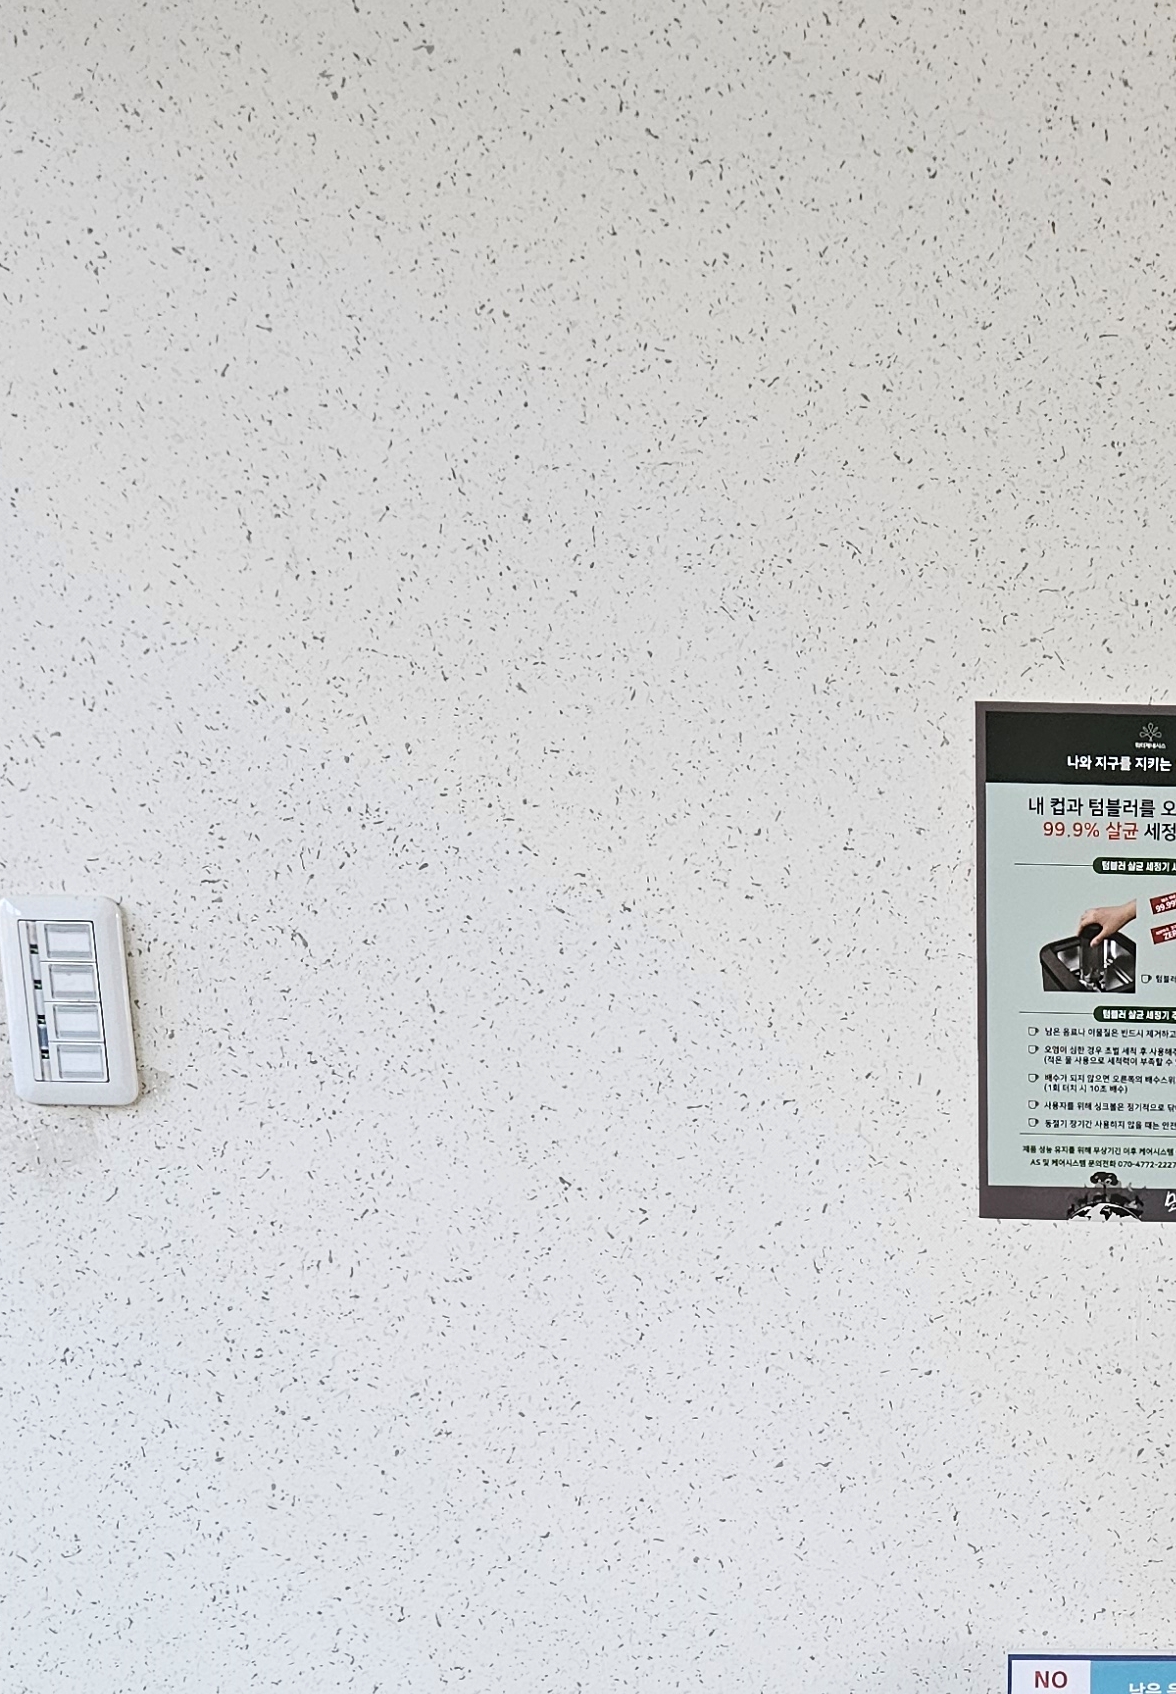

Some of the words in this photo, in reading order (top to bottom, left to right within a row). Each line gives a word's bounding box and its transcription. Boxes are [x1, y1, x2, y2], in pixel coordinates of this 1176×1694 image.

[1067, 755, 1092, 770] 나와
[1095, 756, 1131, 771] 지구를
[1135, 757, 1172, 771] 지키는
[1029, 797, 1044, 816] 내
[1050, 798, 1083, 816] 컵과
[1089, 798, 1155, 818] 텀블러를
[1043, 821, 1100, 838] 99.9%
[1105, 822, 1139, 840] 살균
[1102, 861, 1126, 871] 텀블러
[1128, 861, 1144, 871] 살균
[1146, 862, 1170, 872] 세정기
[1103, 1010, 1126, 1019] 텀블러
[1128, 1010, 1144, 1020] 살균
[1146, 1010, 1169, 1020] 세정기
[1045, 1027, 1060, 1036] 남은
[1062, 1028, 1085, 1037] 음료나
[1088, 1028, 1119, 1037] 이물질은
[1121, 1029, 1143, 1038] 반드시
[1146, 1029, 1176, 1038] 제거하고
[1044, 1045, 1067, 1054] 오염이
[1070, 1046, 1085, 1054] 심한
[1088, 1046, 1102, 1055] 경우
[1105, 1047, 1120, 1055] 초벌
[1122, 1047, 1137, 1055] 세척
[1140, 1047, 1147, 1055] 후
[1044, 1056, 1062, 1065] (적은
[1074, 1057, 1105, 1065] 사용으로
[1108, 1057, 1138, 1066] 세척력이
[1140, 1058, 1163, 1066] 부족할
[1165, 1058, 1173, 1066] 수
[1045, 1074, 1067, 1082] 배수가
[1070, 1074, 1085, 1083] 되지
[1087, 1075, 1110, 1083] 않으면
[1113, 1075, 1143, 1084] 오른쪽의
[1044, 1084, 1060, 1092] (1회
[1063, 1084, 1077, 1092] 터치
[1079, 1085, 1086, 1093] 시
[1090, 1085, 1107, 1093] 10초
[1109, 1085, 1128, 1094] 배수)
[1044, 1102, 1074, 1110] 사용자를
[1077, 1102, 1092, 1111] 위해
[1094, 1103, 1124, 1111] 싱크볼은
[1127, 1103, 1165, 1112] 정기적으로
[1045, 1120, 1067, 1128] 동절기
[1070, 1120, 1092, 1129] 장기간
[1094, 1120, 1125, 1129] 사용하지
[1128, 1121, 1142, 1129] 않을
[1144, 1121, 1160, 1130] 때는
[1022, 1145, 1036, 1153] 제품
[1039, 1146, 1052, 1154] 성능
[1054, 1146, 1075, 1154] 유지를
[1077, 1146, 1091, 1154] 위해
[1093, 1147, 1120, 1155] 무상기간
[1123, 1147, 1137, 1155] 이후
[1139, 1148, 1174, 1156] 케어시스템
[1051, 1159, 1086, 1167] 케어시스템
[1088, 1160, 1116, 1168] 문의전화
[1118, 1160, 1176, 1168] 070-4772-2227
[1034, 1671, 1068, 1689] NO
